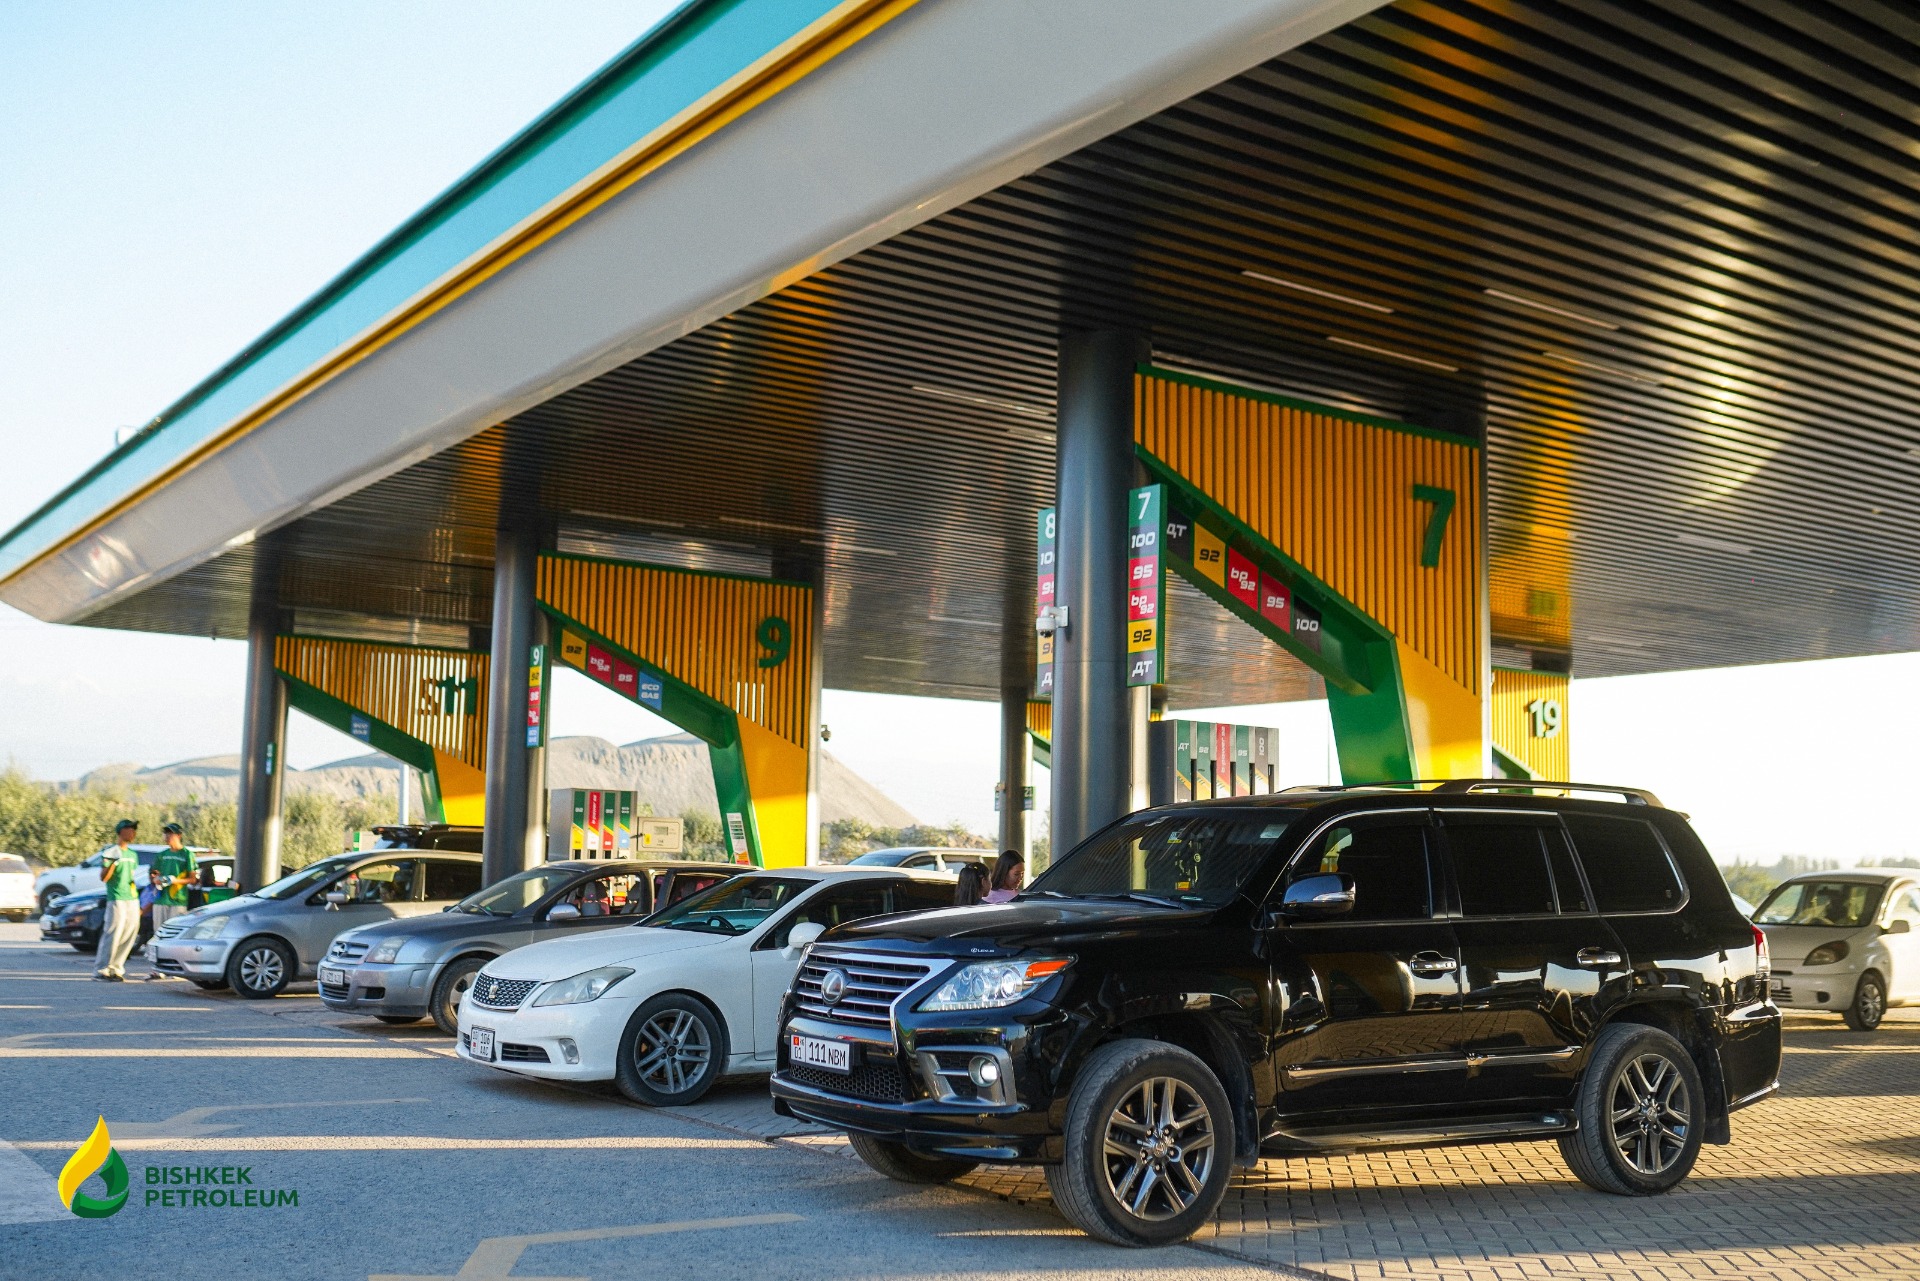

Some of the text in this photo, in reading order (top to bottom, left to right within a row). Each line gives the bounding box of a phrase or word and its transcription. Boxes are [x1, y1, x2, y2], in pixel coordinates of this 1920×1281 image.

[1137, 491, 1151, 520] 7
[1045, 512, 1055, 539] 8
[1411, 483, 1456, 569] 7
[1131, 531, 1156, 549] 100
[1040, 551, 1055, 566] 10
[1199, 548, 1220, 563] 92
[1132, 563, 1154, 581] 95
[1230, 567, 1256, 591] bp 92
[1131, 594, 1155, 615] bp 92
[1266, 596, 1285, 609] 95
[1296, 618, 1319, 632] 100
[757, 616, 791, 669] 9
[1132, 628, 1152, 644] 92
[533, 647, 540, 666] 9
[566, 645, 582, 655] 92
[1042, 642, 1054, 656] 9
[618, 673, 633, 682] 95
[1131, 659, 1153, 678] ДТ
[641, 683, 660, 691] ECO
[1041, 671, 1053, 687] Д
[436, 675, 478, 715] 11
[1527, 698, 1562, 739] 19
[1178, 742, 1189, 751] ДТ
[1237, 749, 1248, 757] 95
[808, 1041, 846, 1067] 111 NBM
